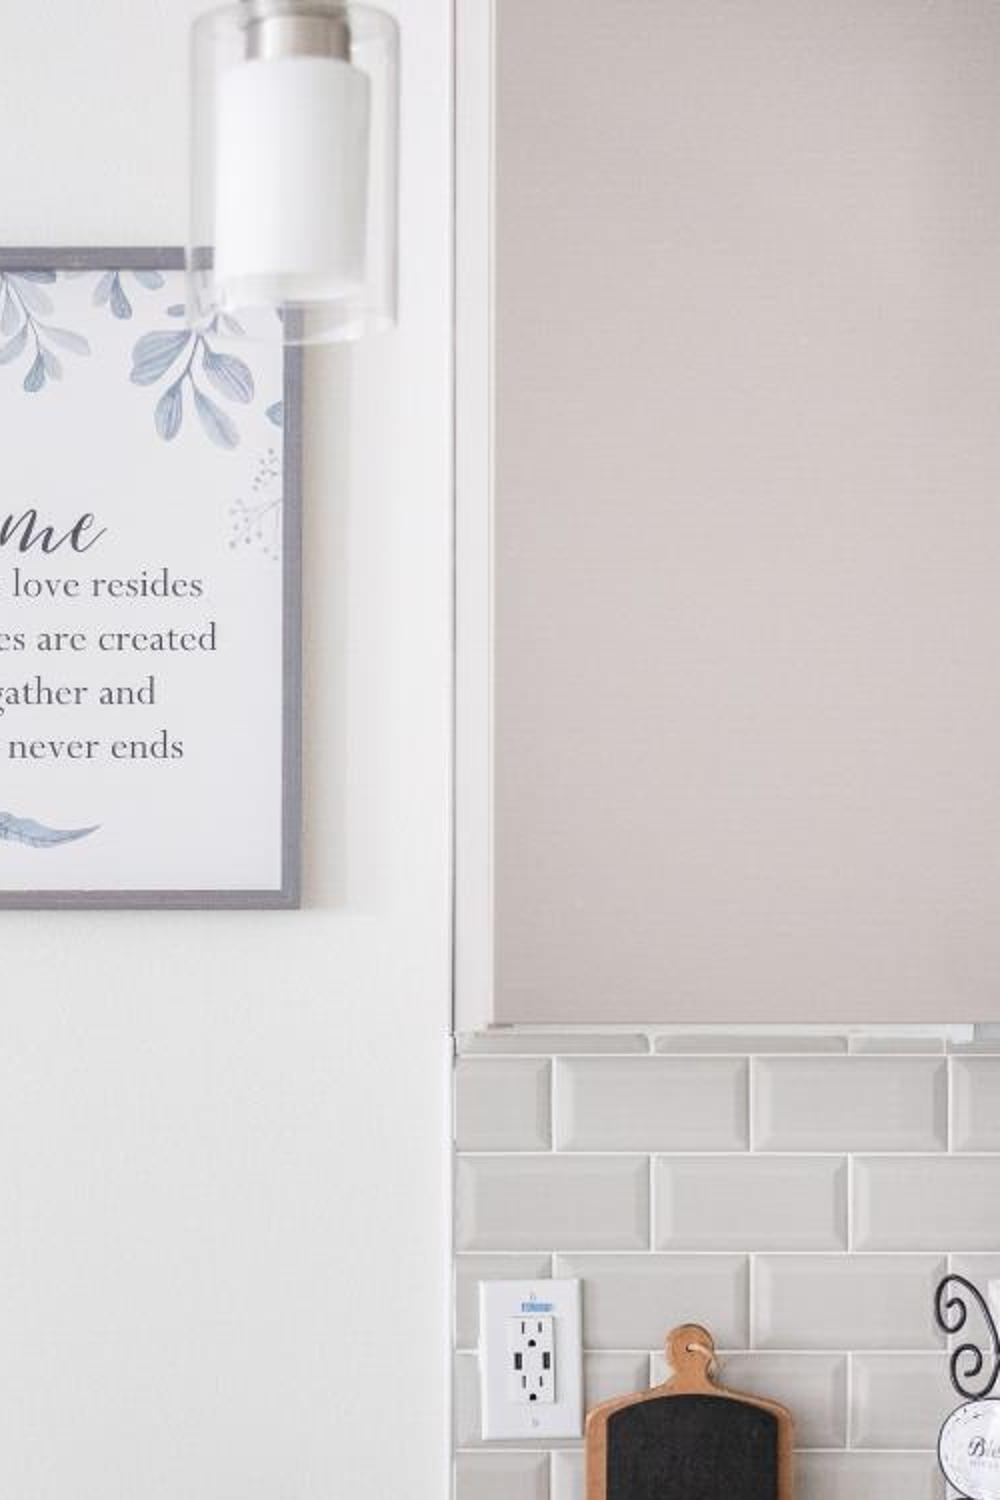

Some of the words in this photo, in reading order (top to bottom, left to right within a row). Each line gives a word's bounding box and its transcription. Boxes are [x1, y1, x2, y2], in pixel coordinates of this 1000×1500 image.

[13, 567, 80, 598] love
[92, 567, 204, 598] resides
[37, 632, 87, 652] are
[98, 621, 217, 652] created
[99, 675, 156, 706] and
[8, 740, 100, 760] never
[111, 729, 184, 760] ends
